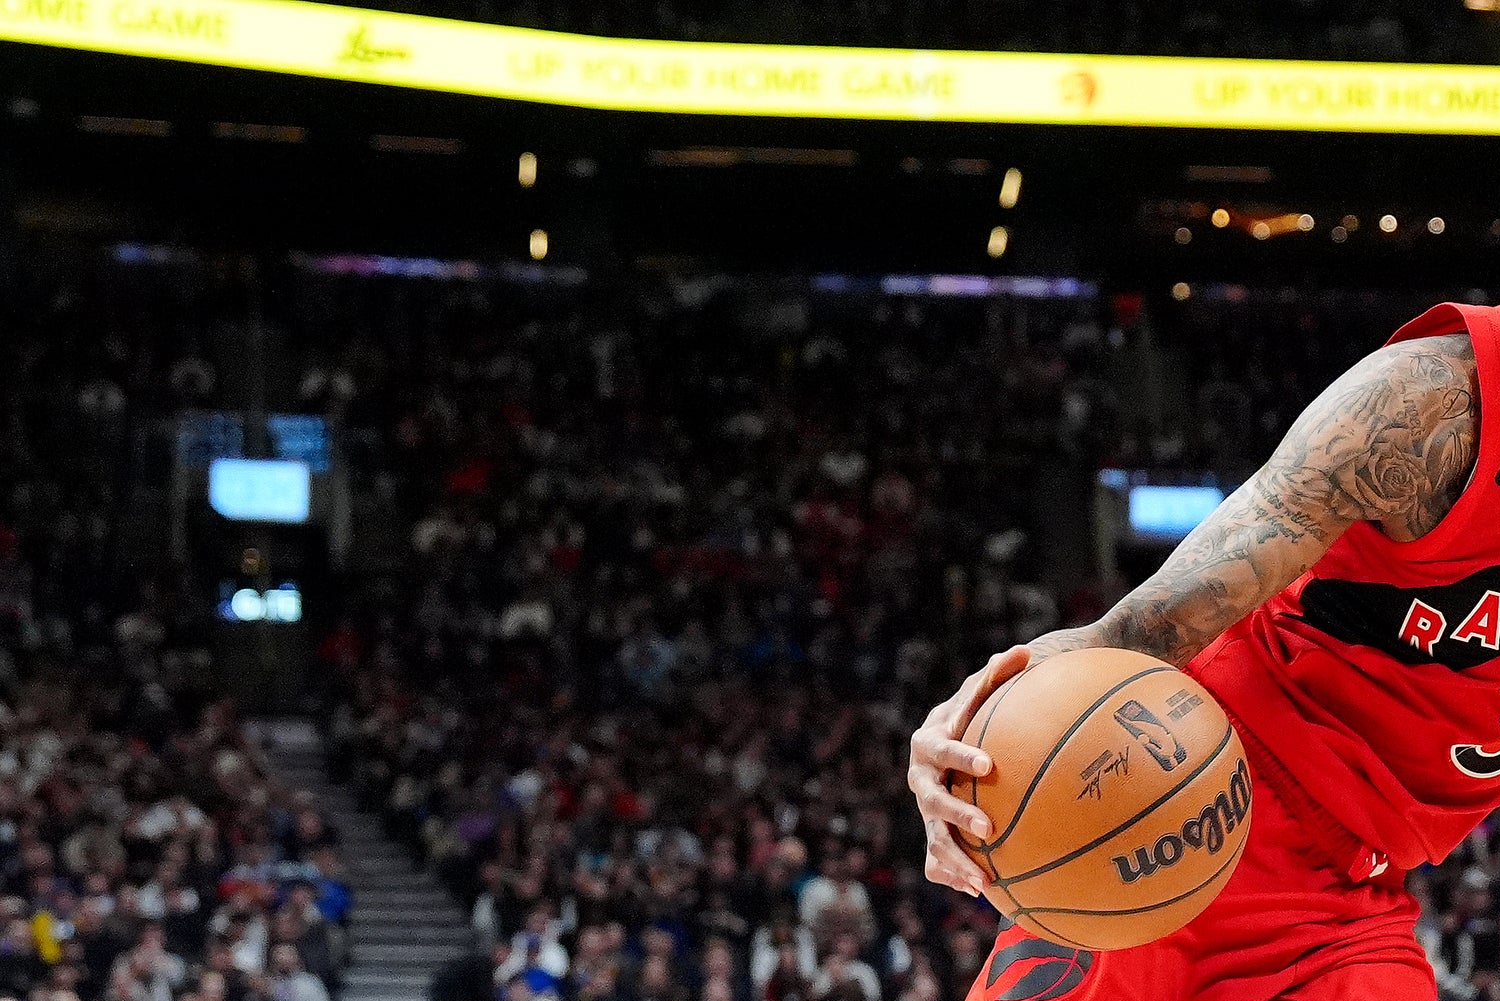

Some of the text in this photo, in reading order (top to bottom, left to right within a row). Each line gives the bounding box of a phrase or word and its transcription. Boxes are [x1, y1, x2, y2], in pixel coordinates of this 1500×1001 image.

[0, 0, 87, 25] OME
[508, 50, 956, 98] UP YOUR HOME GAME
[1193, 77, 1251, 112] UP
[1265, 78, 1376, 116] YOUR
[1111, 758, 1253, 884] Wilson
